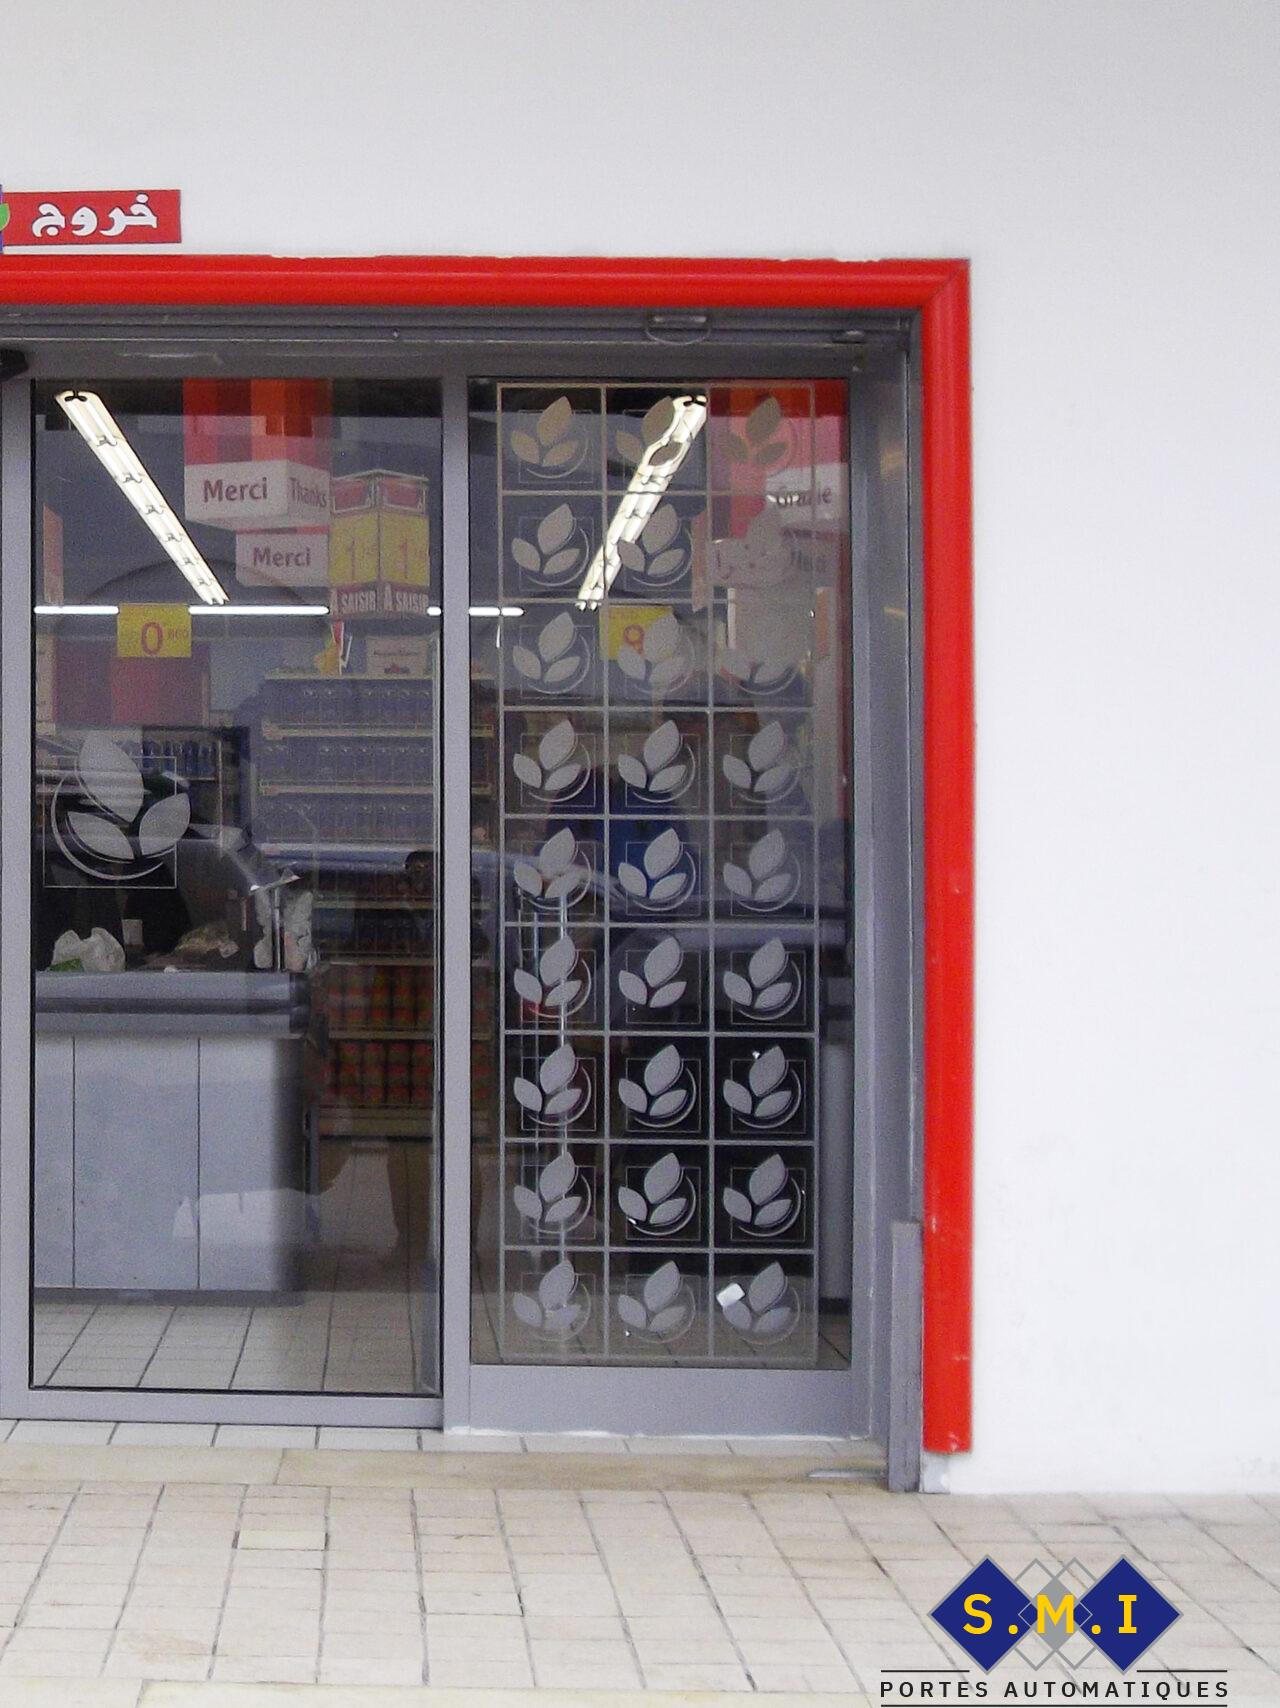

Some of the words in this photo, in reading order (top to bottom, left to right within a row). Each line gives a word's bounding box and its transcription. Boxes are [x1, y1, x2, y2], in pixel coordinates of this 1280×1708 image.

[31, 193, 158, 238] خروج
[203, 476, 268, 503] Merci
[289, 477, 327, 508] Thanks
[253, 546, 311, 567] Merci
